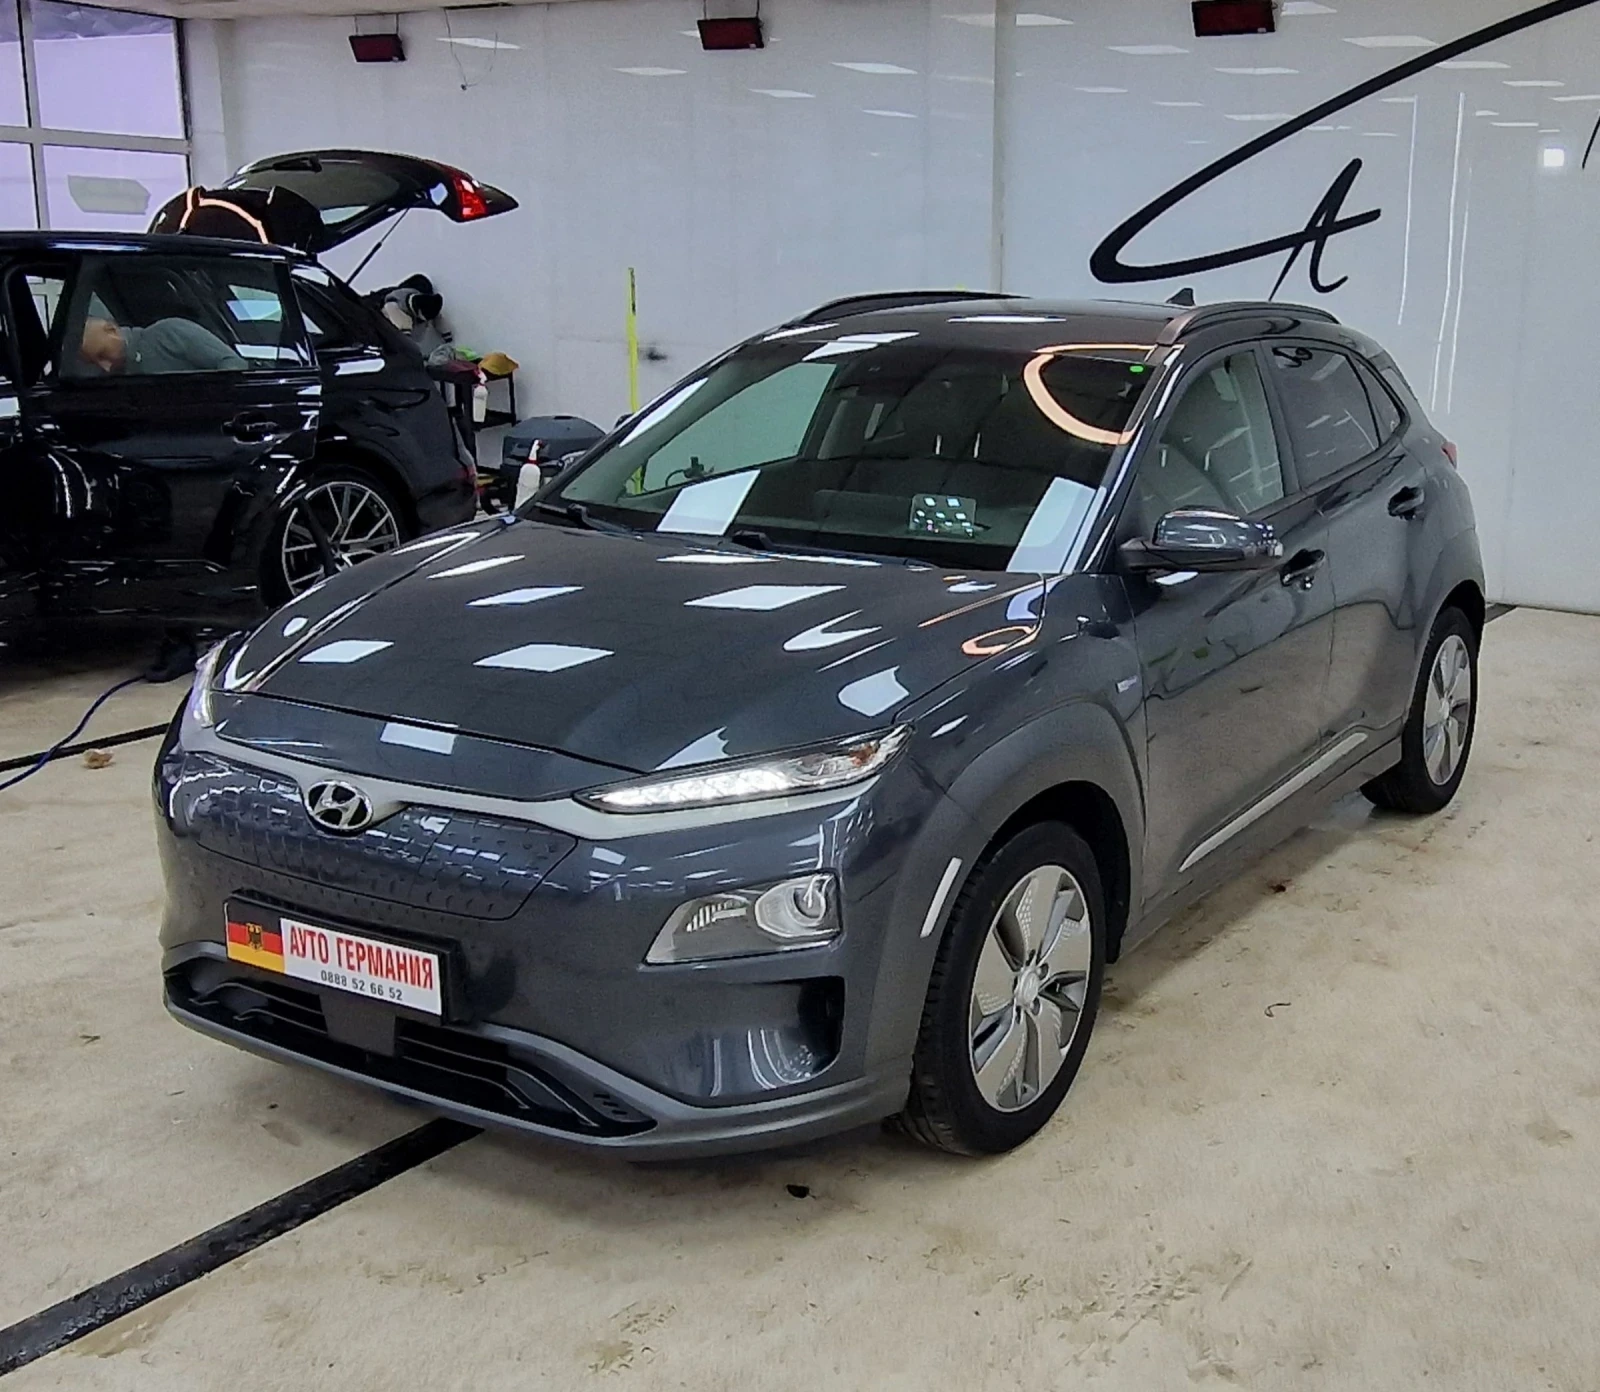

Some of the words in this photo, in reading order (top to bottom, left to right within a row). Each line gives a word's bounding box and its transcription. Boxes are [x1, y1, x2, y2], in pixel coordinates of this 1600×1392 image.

[290, 925, 329, 964] АУТО
[336, 937, 434, 990] ГЕРМАНИЯ
[320, 969, 348, 987] 0888
[352, 978, 365, 992] 52
[370, 982, 384, 996] 66
[389, 987, 403, 1000] 52
